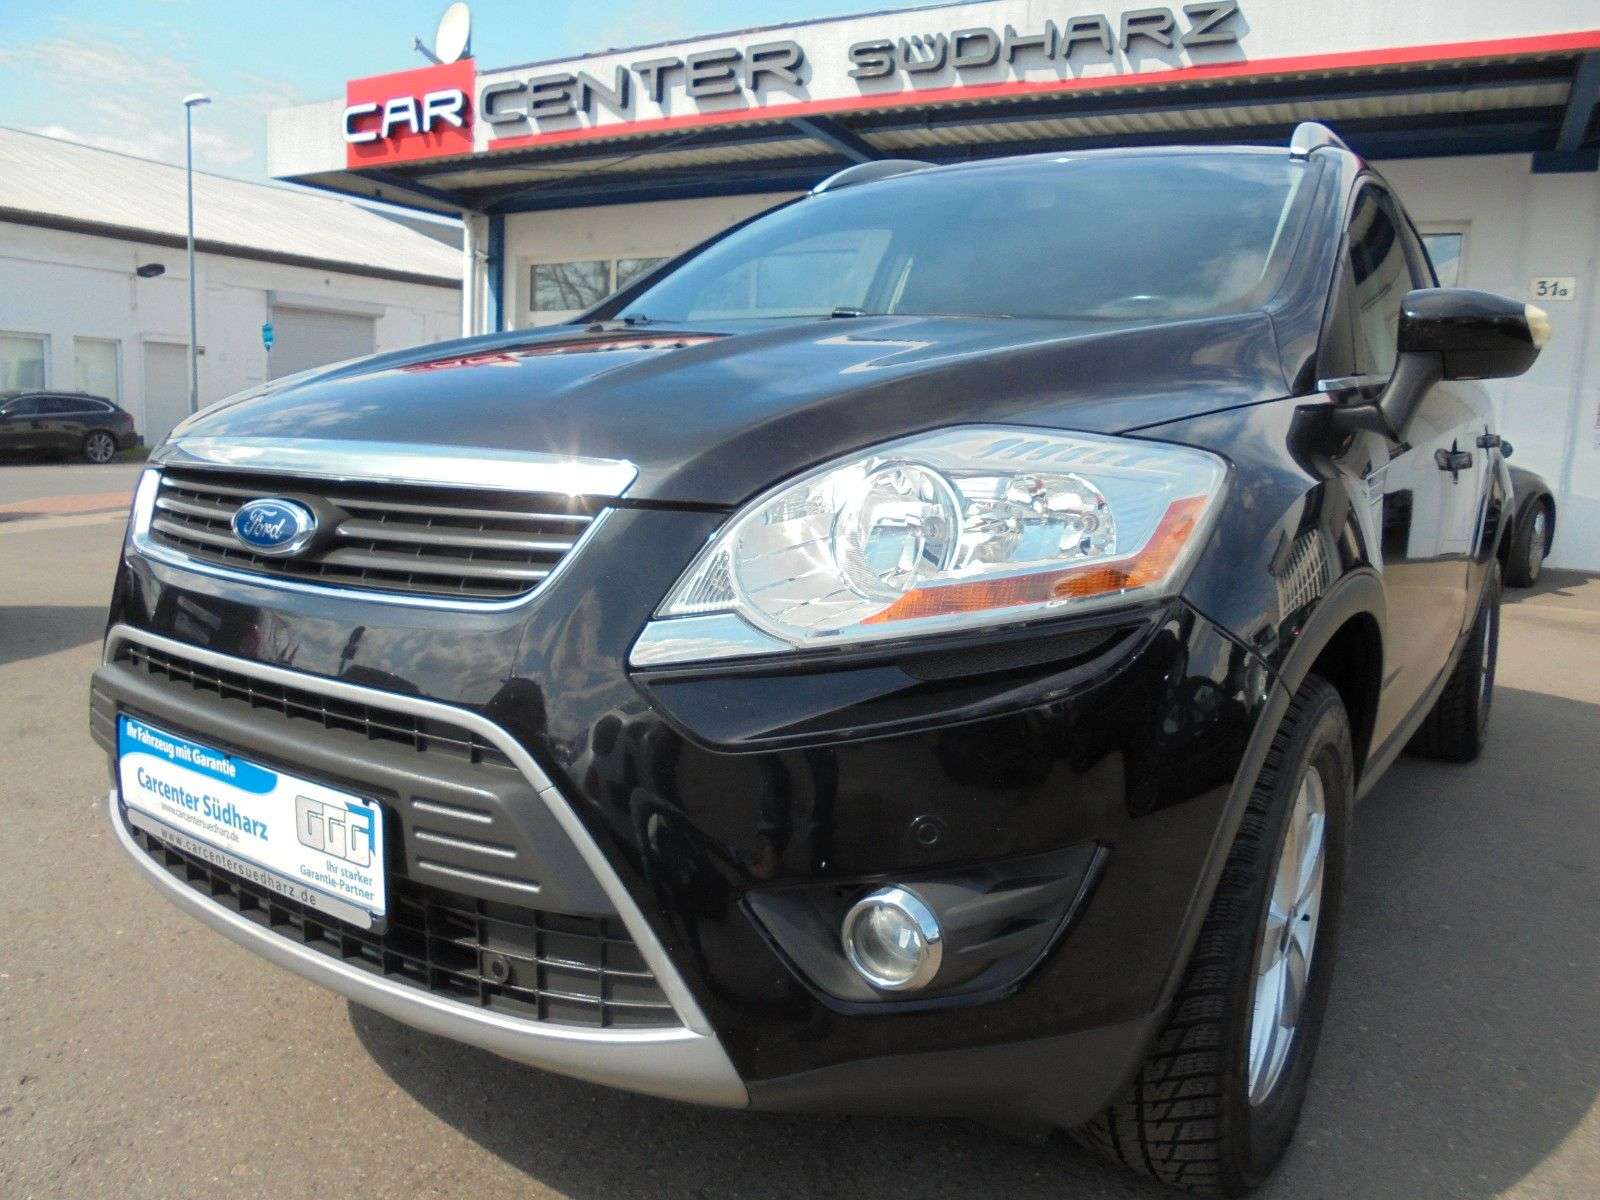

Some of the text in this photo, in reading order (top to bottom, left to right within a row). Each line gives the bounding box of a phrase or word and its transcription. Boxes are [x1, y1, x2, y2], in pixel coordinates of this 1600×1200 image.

[342, 88, 465, 144] CAR
[480, 40, 805, 126] CENTER
[1537, 280, 1568, 297] 31a
[244, 508, 286, 540] Ford
[126, 721, 236, 777] Ihr Fahrzeug mit Garantie
[137, 766, 269, 842] Carcenter Südharz
[160, 827, 318, 906] www.carcentersuedharz.de
[299, 863, 375, 901] Garantie-Partner
[326, 860, 373, 887] Ihr starker
